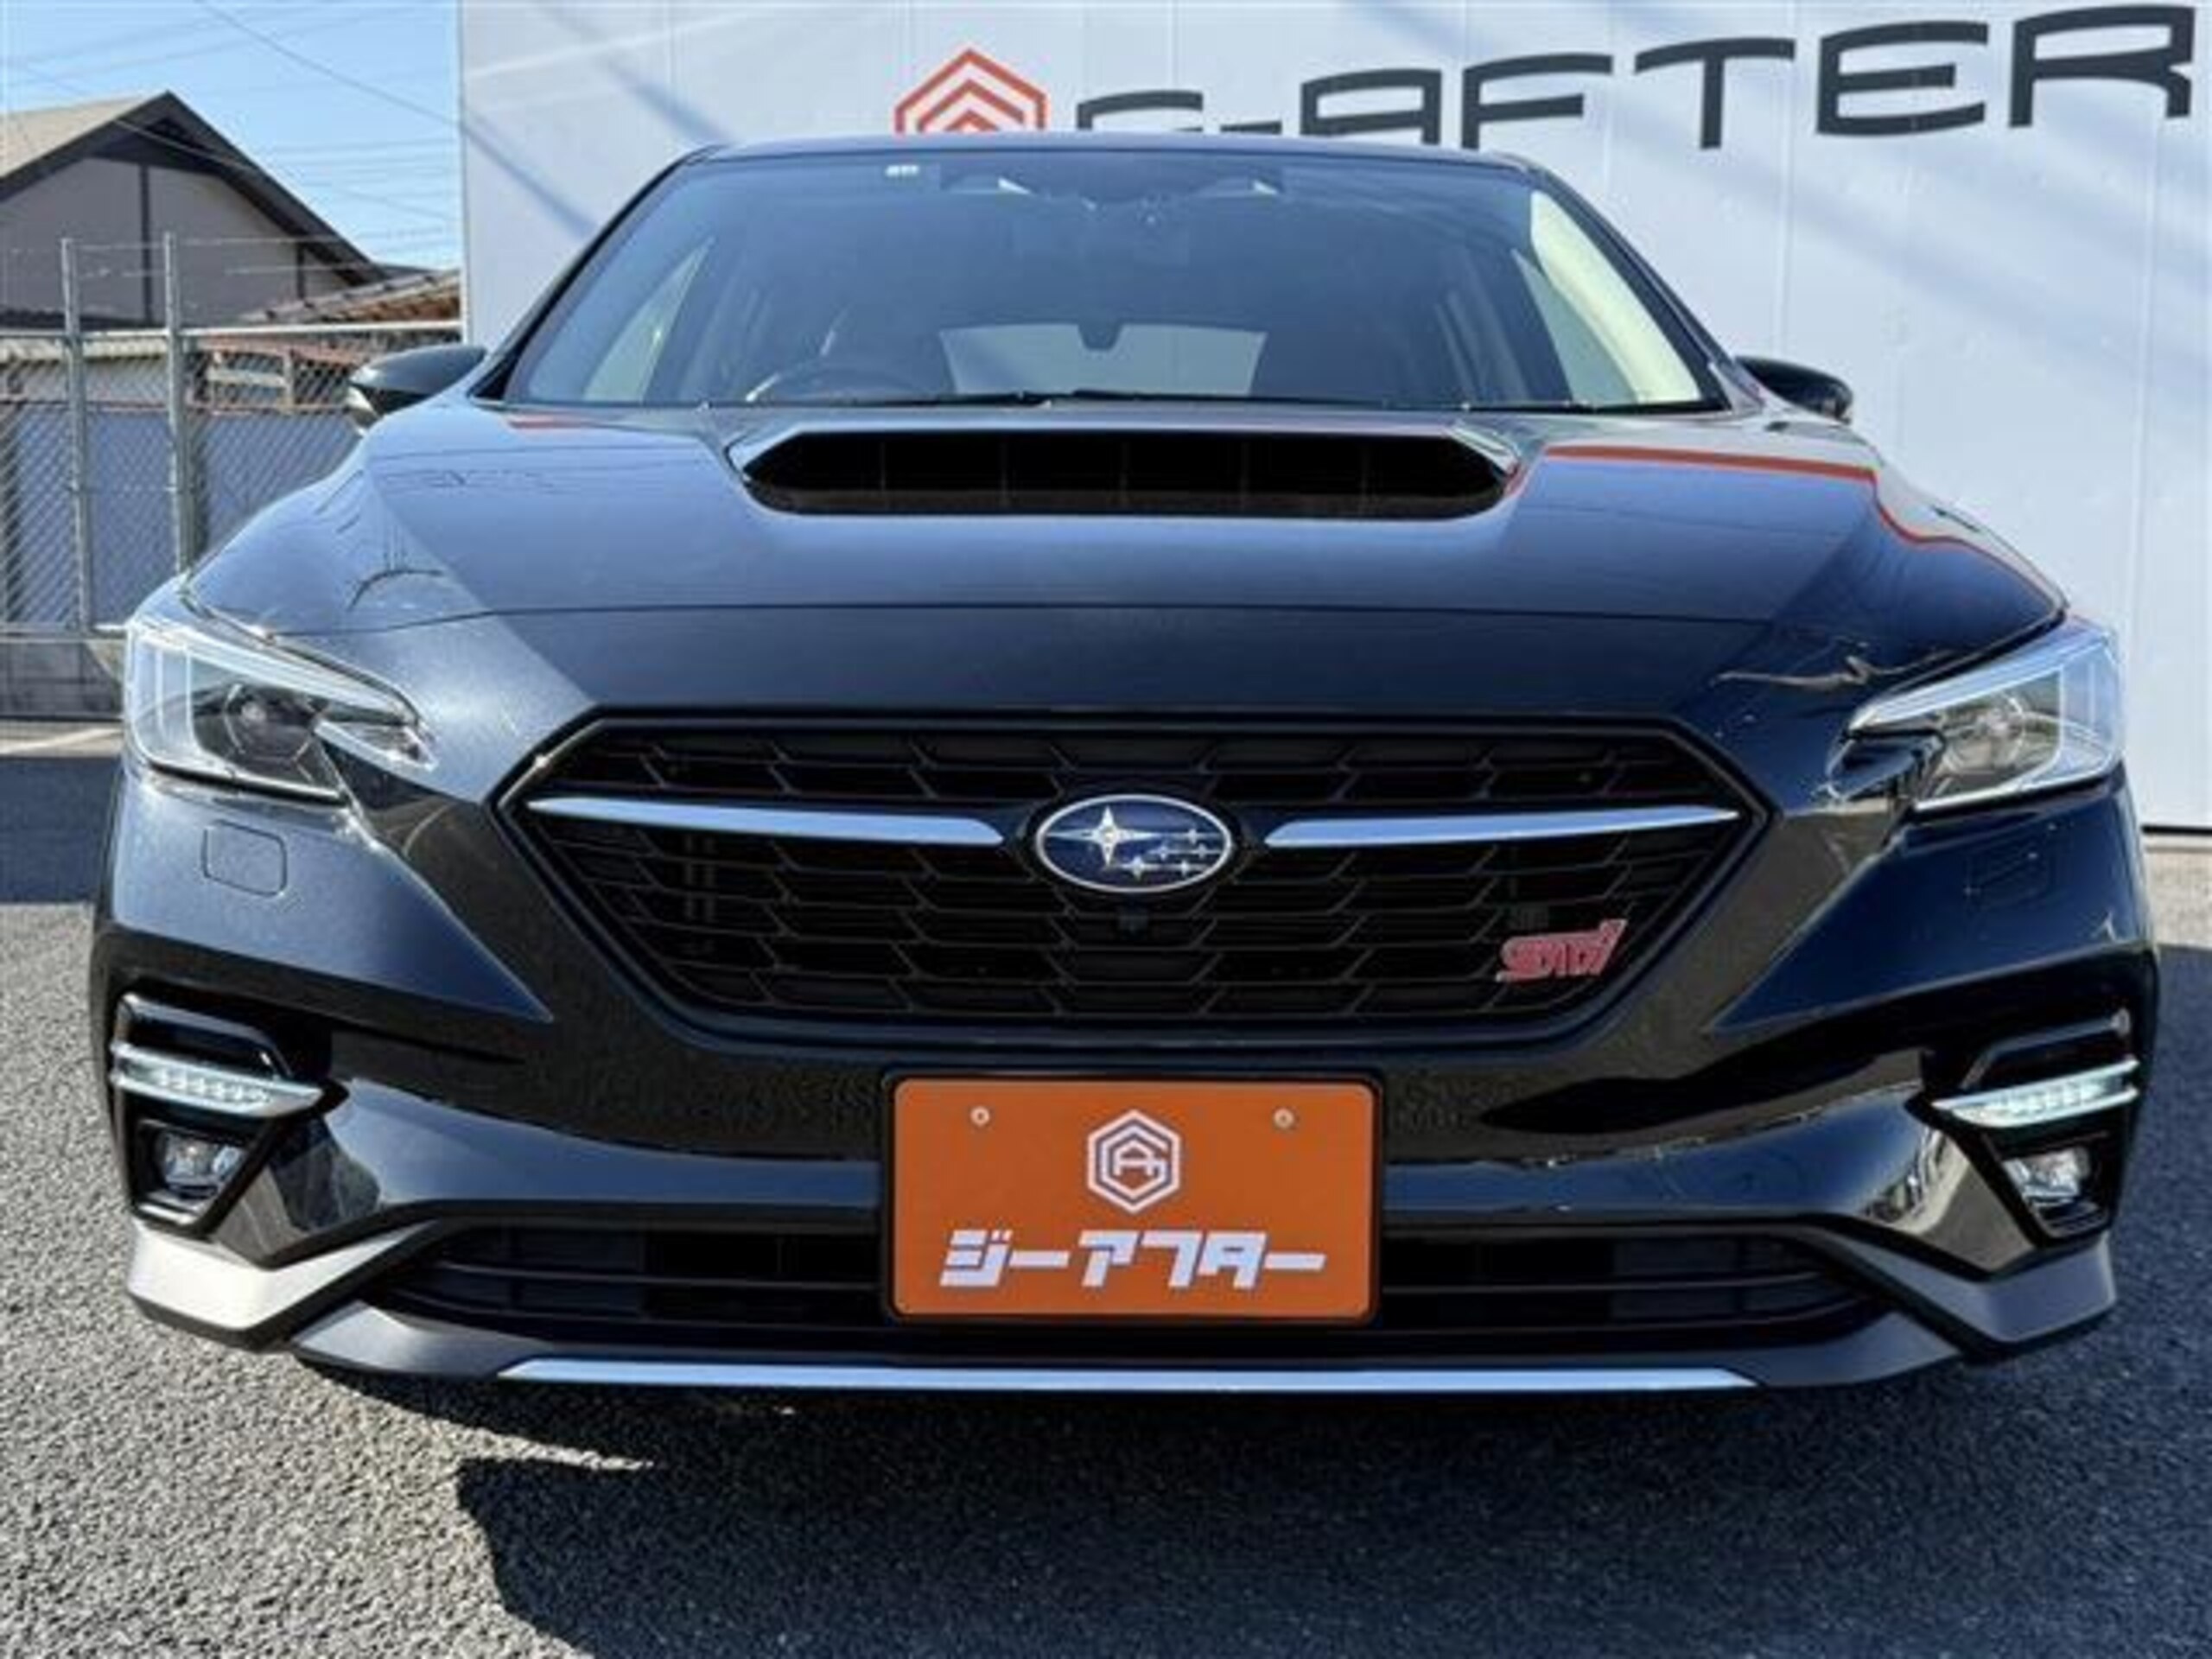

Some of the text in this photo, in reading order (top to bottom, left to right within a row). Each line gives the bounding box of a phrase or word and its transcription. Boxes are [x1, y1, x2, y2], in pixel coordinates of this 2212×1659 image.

[939, 1230, 1326, 1288] ジーアフター
